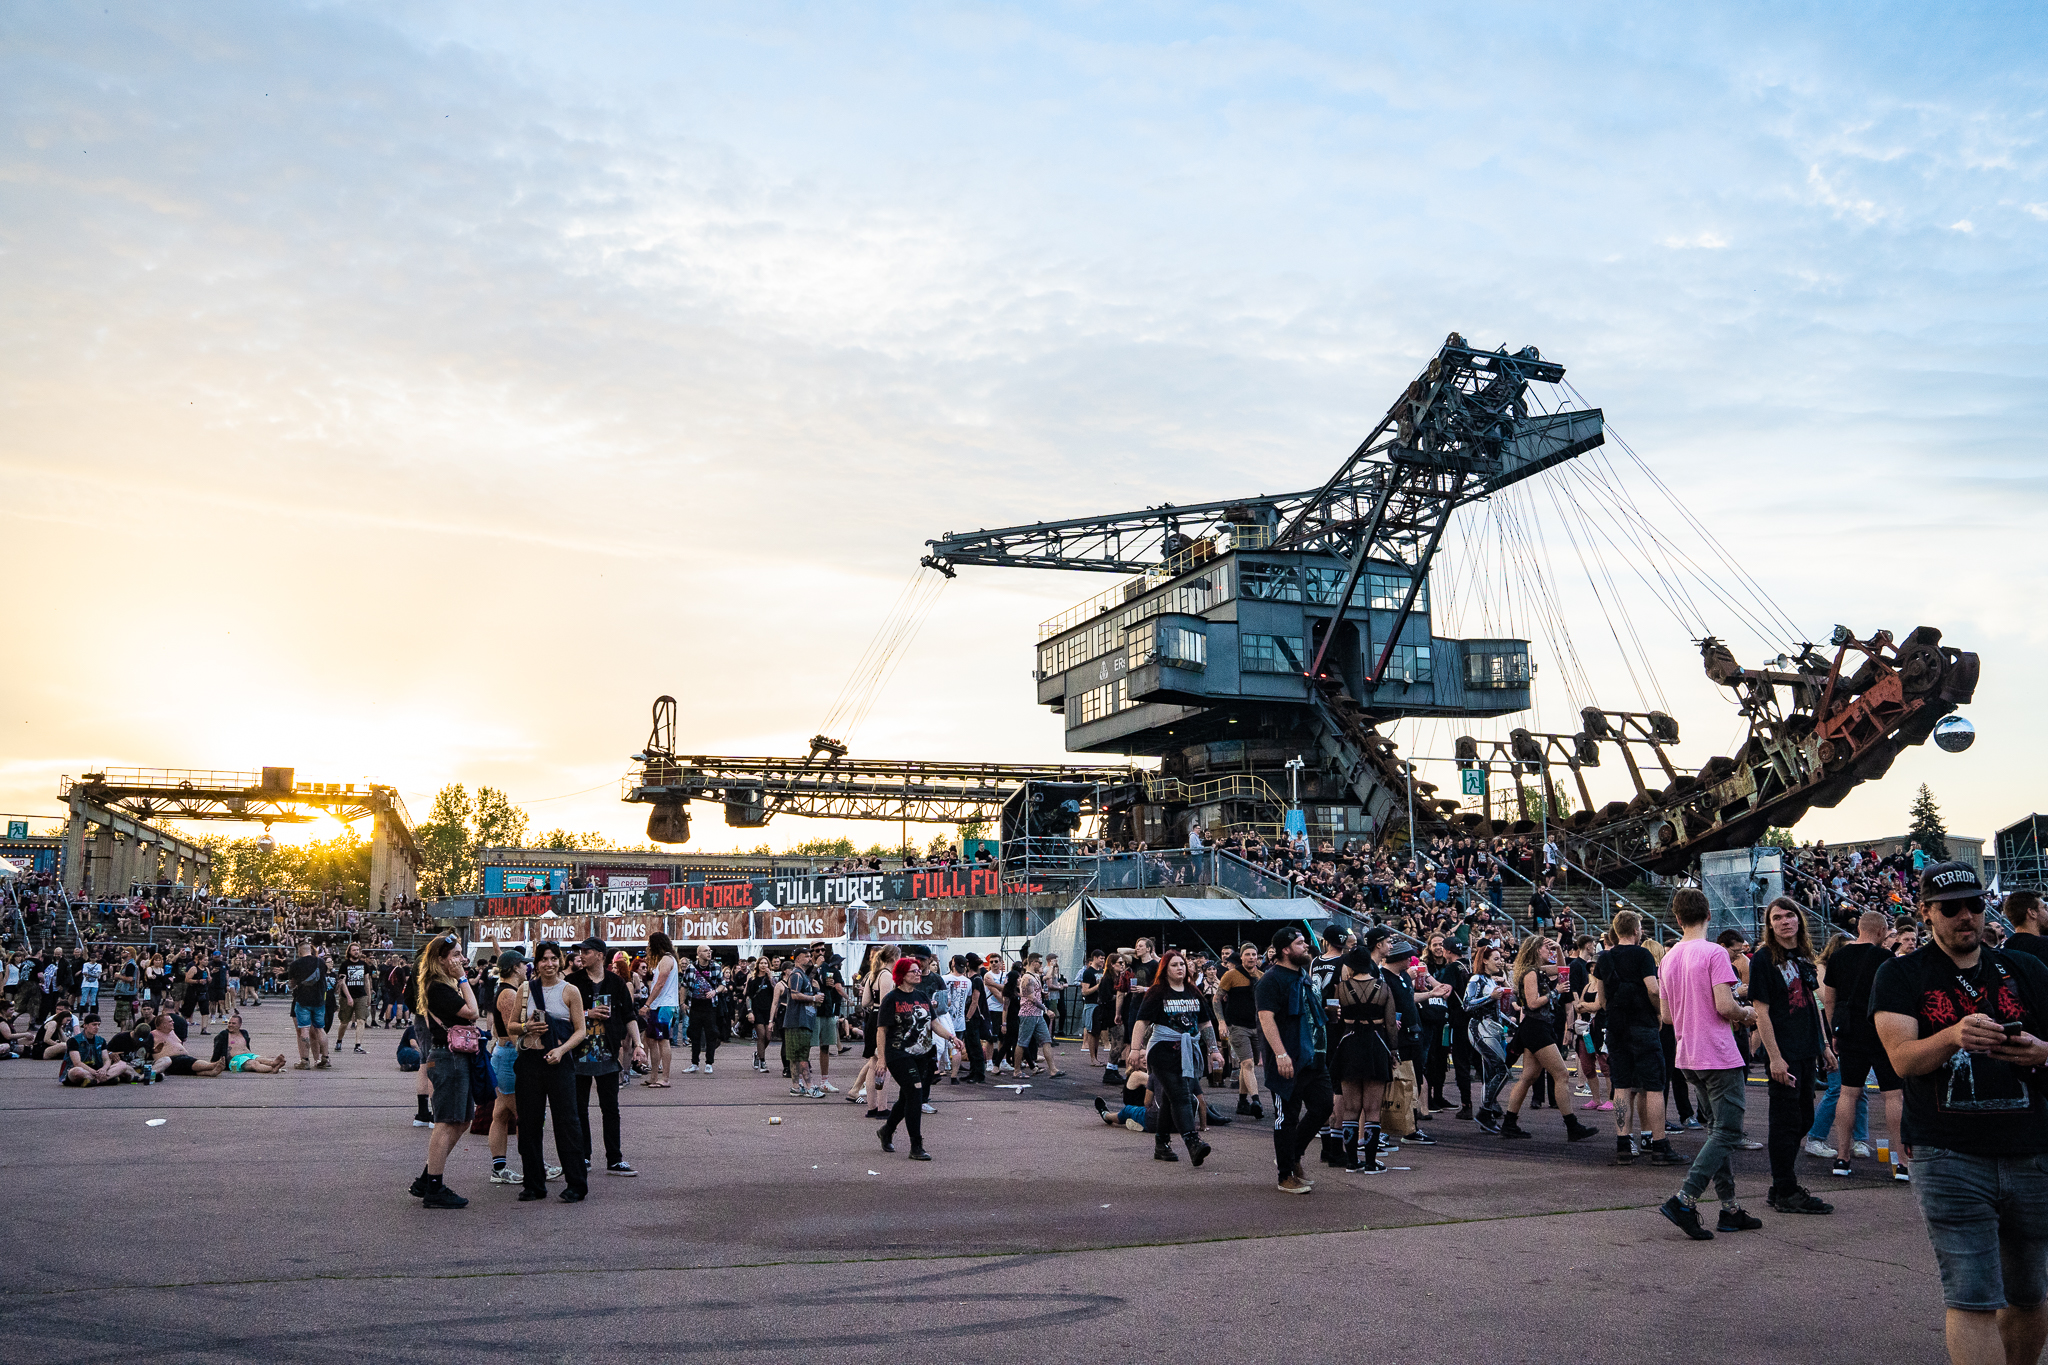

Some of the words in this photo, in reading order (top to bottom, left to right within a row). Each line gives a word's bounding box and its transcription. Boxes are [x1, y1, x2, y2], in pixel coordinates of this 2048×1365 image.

[912, 870, 966, 899] FULL
[1932, 870, 1976, 888] TERROR
[663, 887, 700, 910] FULL
[703, 883, 753, 908] FORCE
[776, 880, 821, 905] FULL
[824, 875, 884, 903] FORCE
[488, 898, 514, 916] FULL
[516, 895, 552, 915] FORCE
[568, 892, 600, 914] FULL
[602, 890, 645, 912] FORCE
[480, 922, 512, 940] Drinks
[541, 920, 576, 940] Drinks
[607, 919, 647, 938] Drinks
[684, 916, 729, 937] Drinks
[773, 913, 824, 935] Drinks
[877, 914, 933, 935] Drinks
[1955, 974, 1978, 998] SONY
